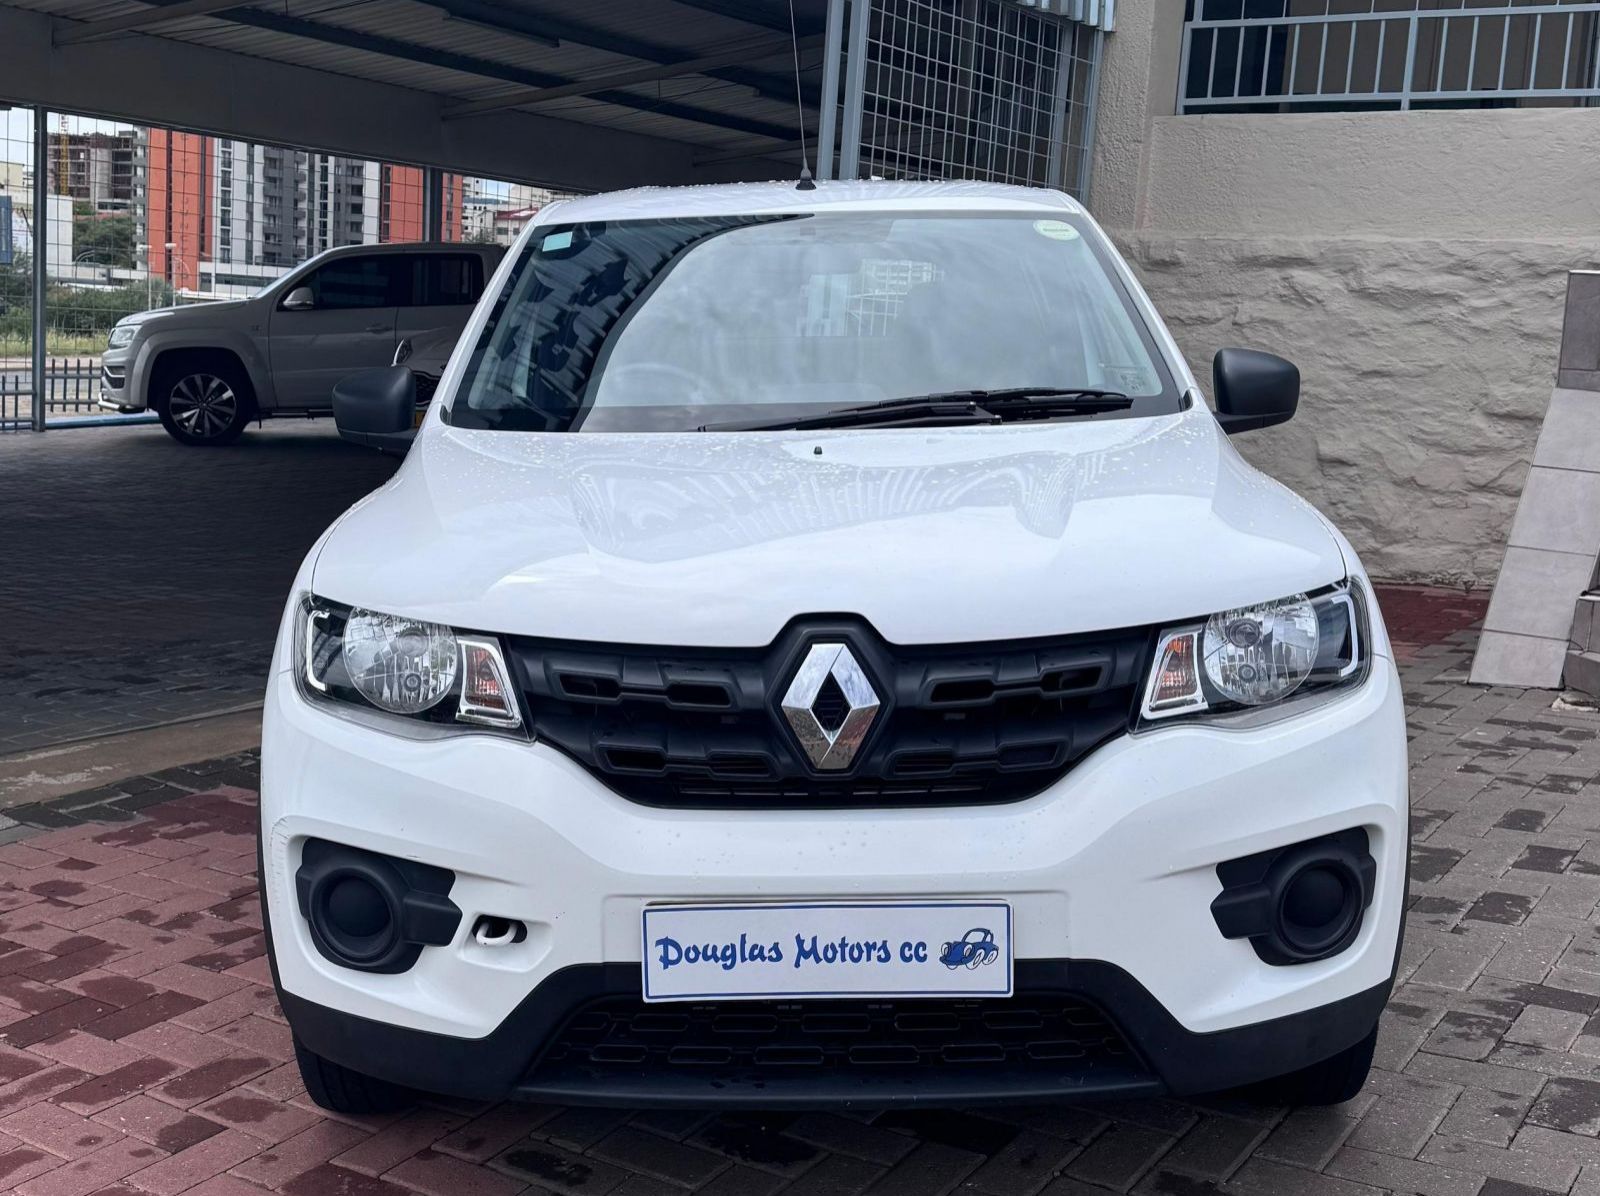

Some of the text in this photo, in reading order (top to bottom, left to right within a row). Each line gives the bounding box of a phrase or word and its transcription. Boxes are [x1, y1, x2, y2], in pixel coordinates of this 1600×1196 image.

[654, 933, 928, 971] Douglas Motors cc
